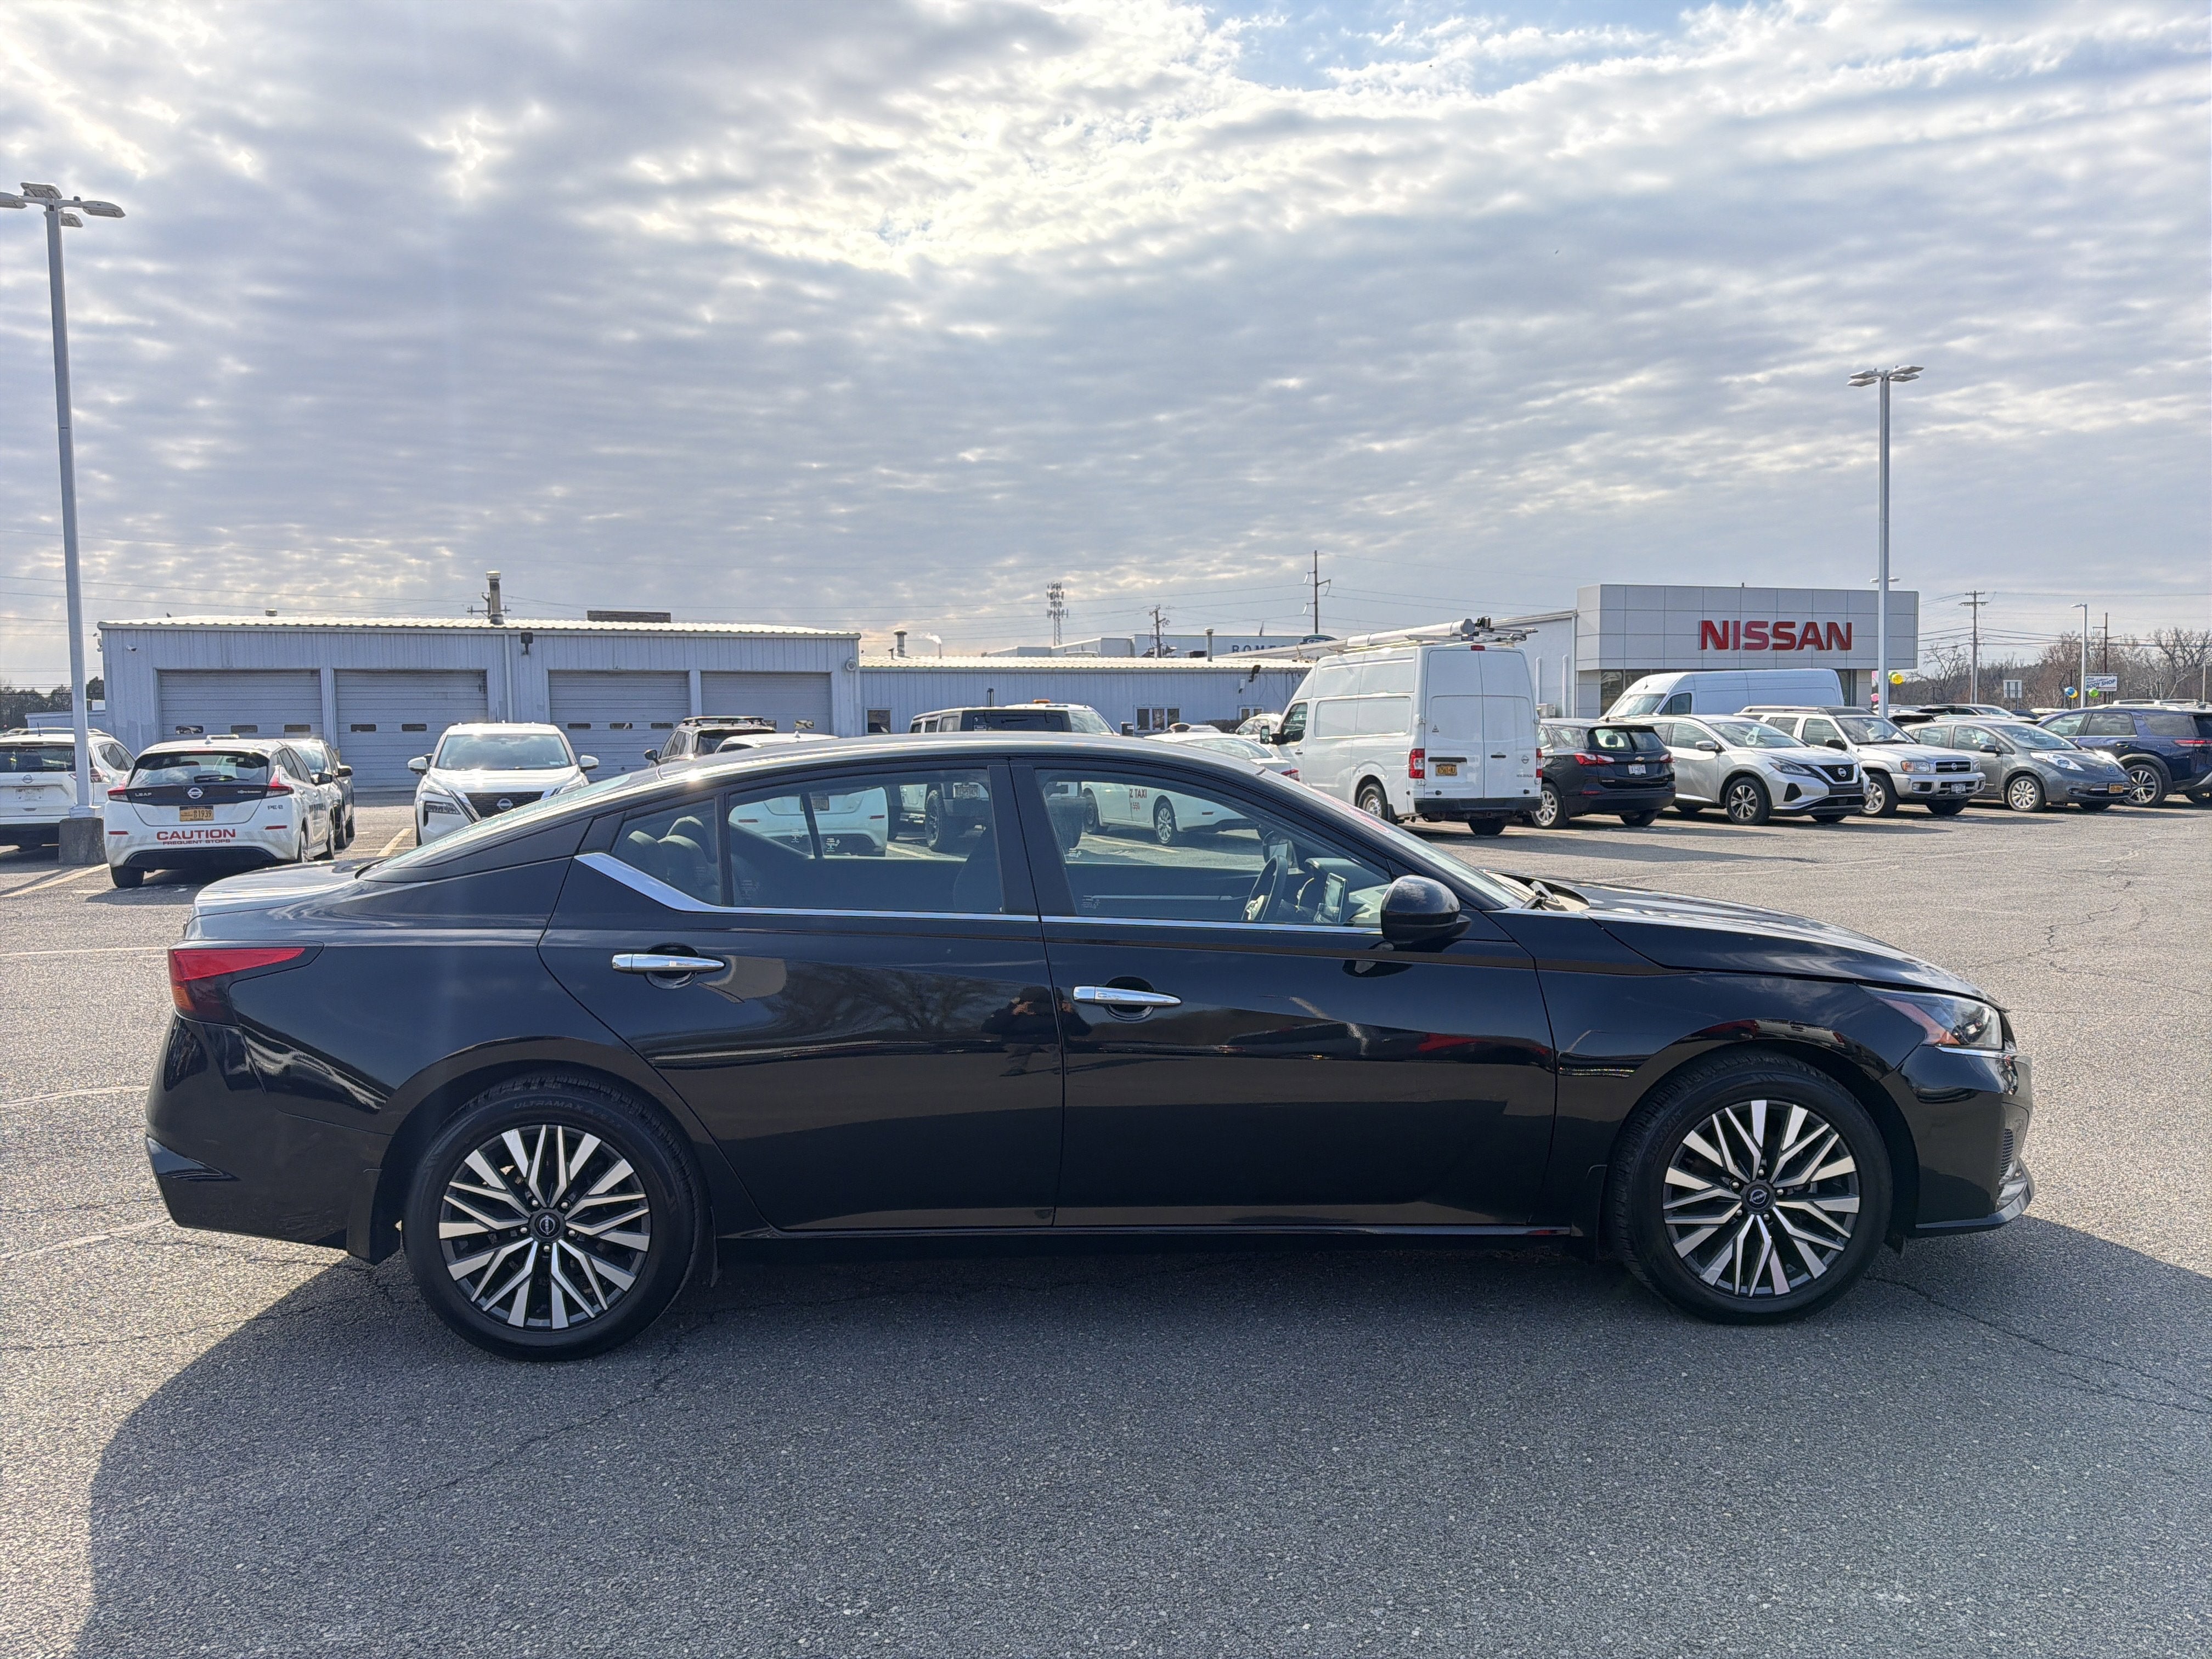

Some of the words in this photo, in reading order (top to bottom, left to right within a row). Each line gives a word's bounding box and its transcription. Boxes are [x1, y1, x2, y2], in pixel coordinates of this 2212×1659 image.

[1700, 620, 1852, 650] NISSAN
[1134, 788, 1147, 798] TAXI
[156, 828, 236, 840] CAUTION
[514, 1099, 584, 1111] ULTRAMAX
